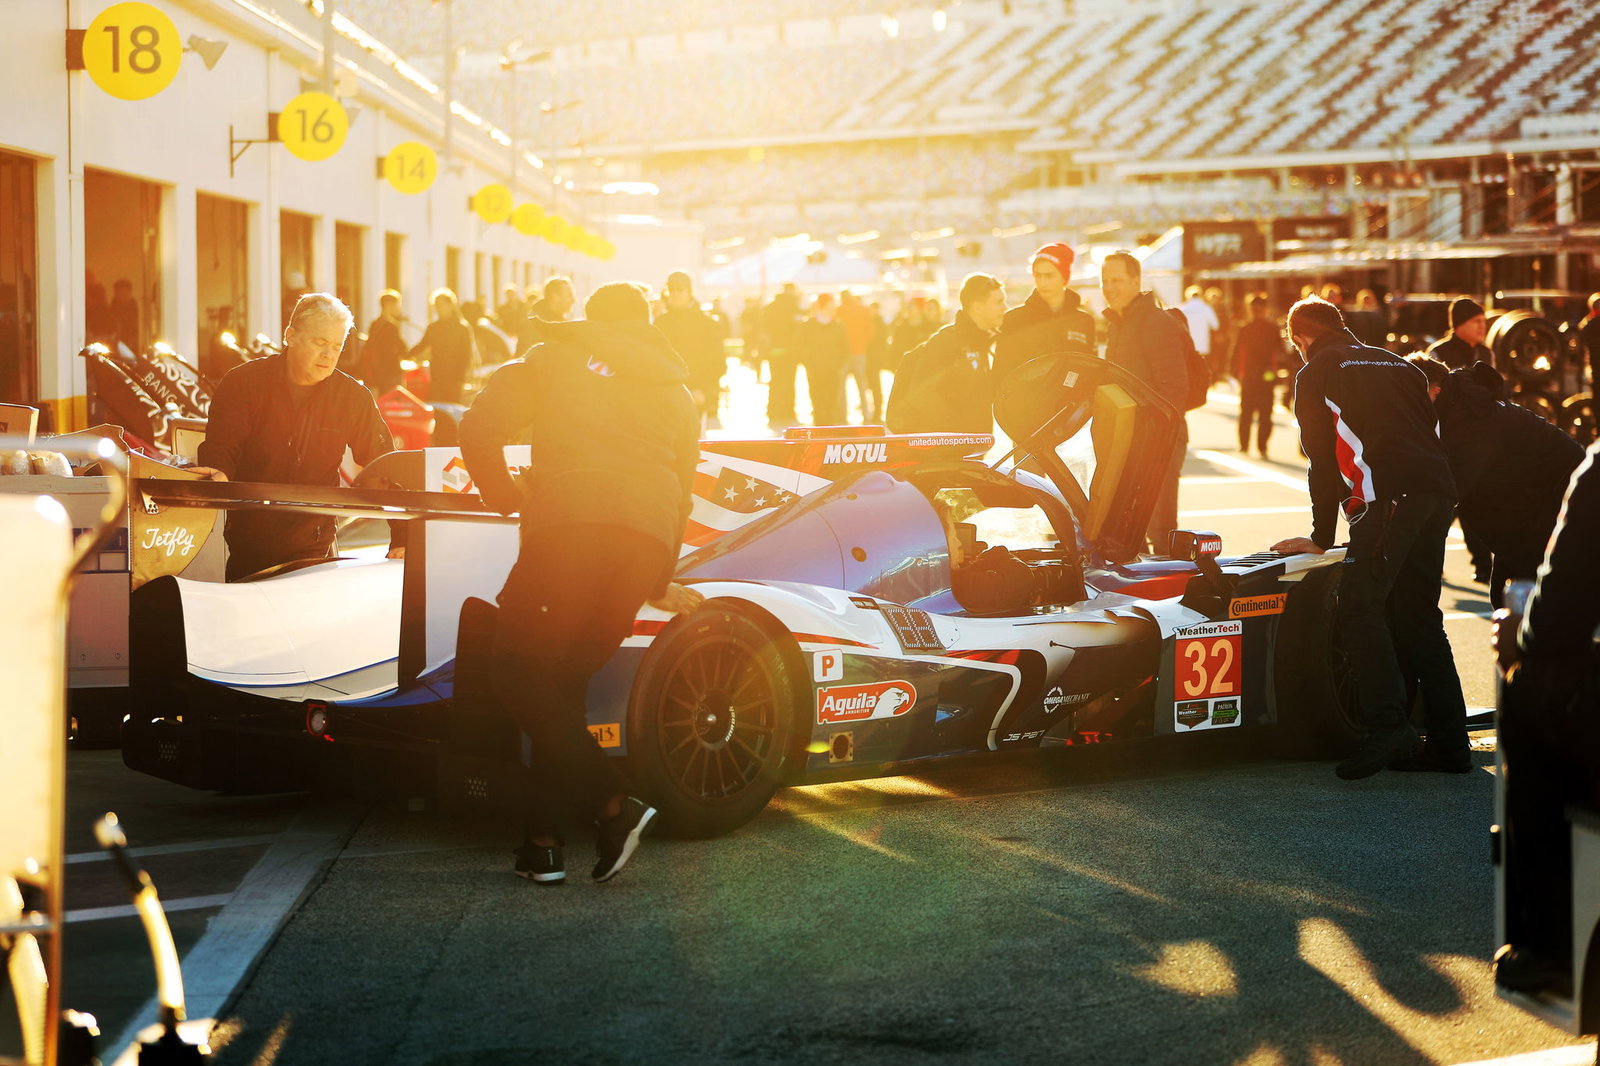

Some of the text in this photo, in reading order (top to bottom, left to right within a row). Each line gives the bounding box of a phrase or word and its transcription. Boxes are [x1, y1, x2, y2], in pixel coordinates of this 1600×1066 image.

[101, 25, 162, 74] 18
[295, 108, 335, 144] 16
[396, 153, 427, 182] 14
[908, 436, 992, 447] unitedautosports.com
[823, 443, 888, 464] MOTUL
[142, 528, 195, 557] Jetfly
[1232, 595, 1279, 616] Continental
[1177, 623, 1240, 636] WeatherTech
[821, 655, 835, 677] P
[1183, 639, 1234, 697] 32
[821, 693, 877, 716] Aguila
